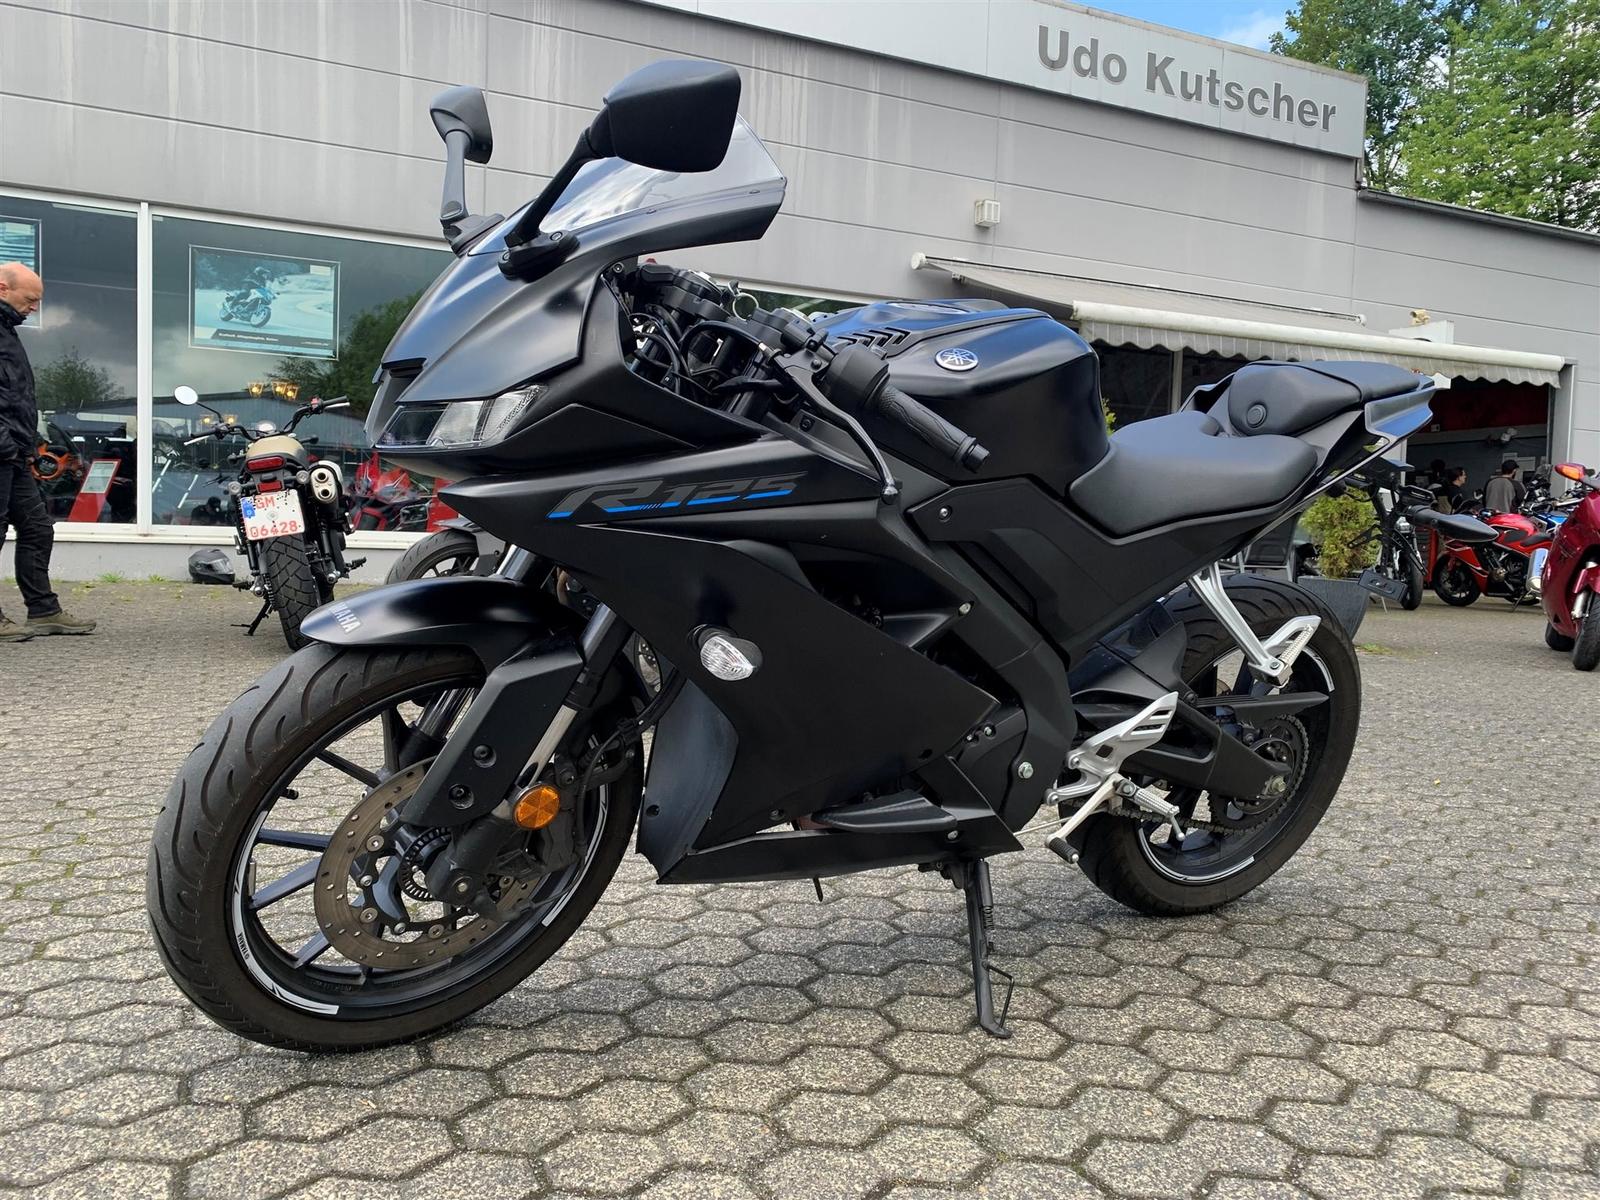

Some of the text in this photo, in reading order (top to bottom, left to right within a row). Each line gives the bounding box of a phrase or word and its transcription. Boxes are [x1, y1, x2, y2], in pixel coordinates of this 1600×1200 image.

[1037, 25, 1338, 132] Udo Kutscher
[255, 496, 275, 509] GM
